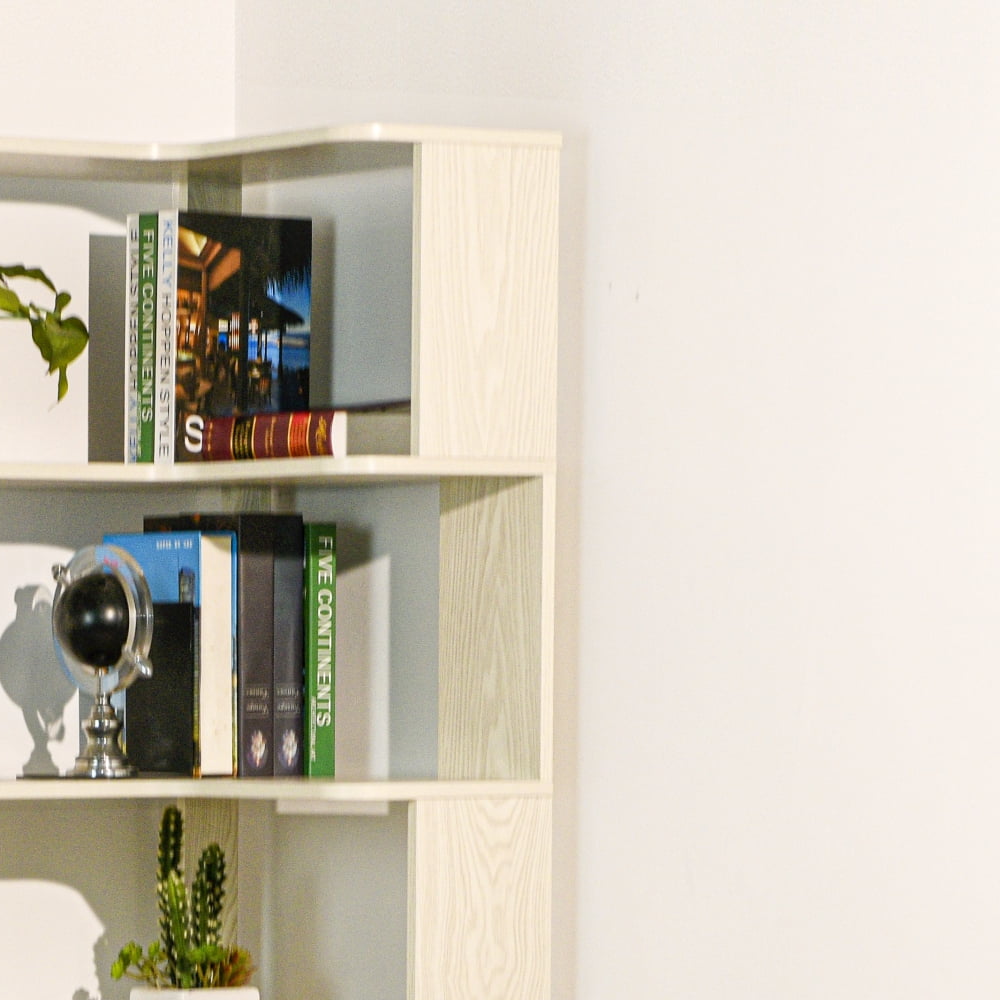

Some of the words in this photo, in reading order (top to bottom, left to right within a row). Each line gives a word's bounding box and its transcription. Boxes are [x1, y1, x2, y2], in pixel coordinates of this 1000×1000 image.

[142, 228, 155, 278] FIVE
[162, 219, 174, 288] KELLY
[140, 282, 154, 423] CONTINENTS
[160, 290, 172, 384] HOPPEN
[158, 388, 171, 457] STYLE
[317, 535, 333, 585] FIVE
[315, 588, 332, 728] CONTINENTS
